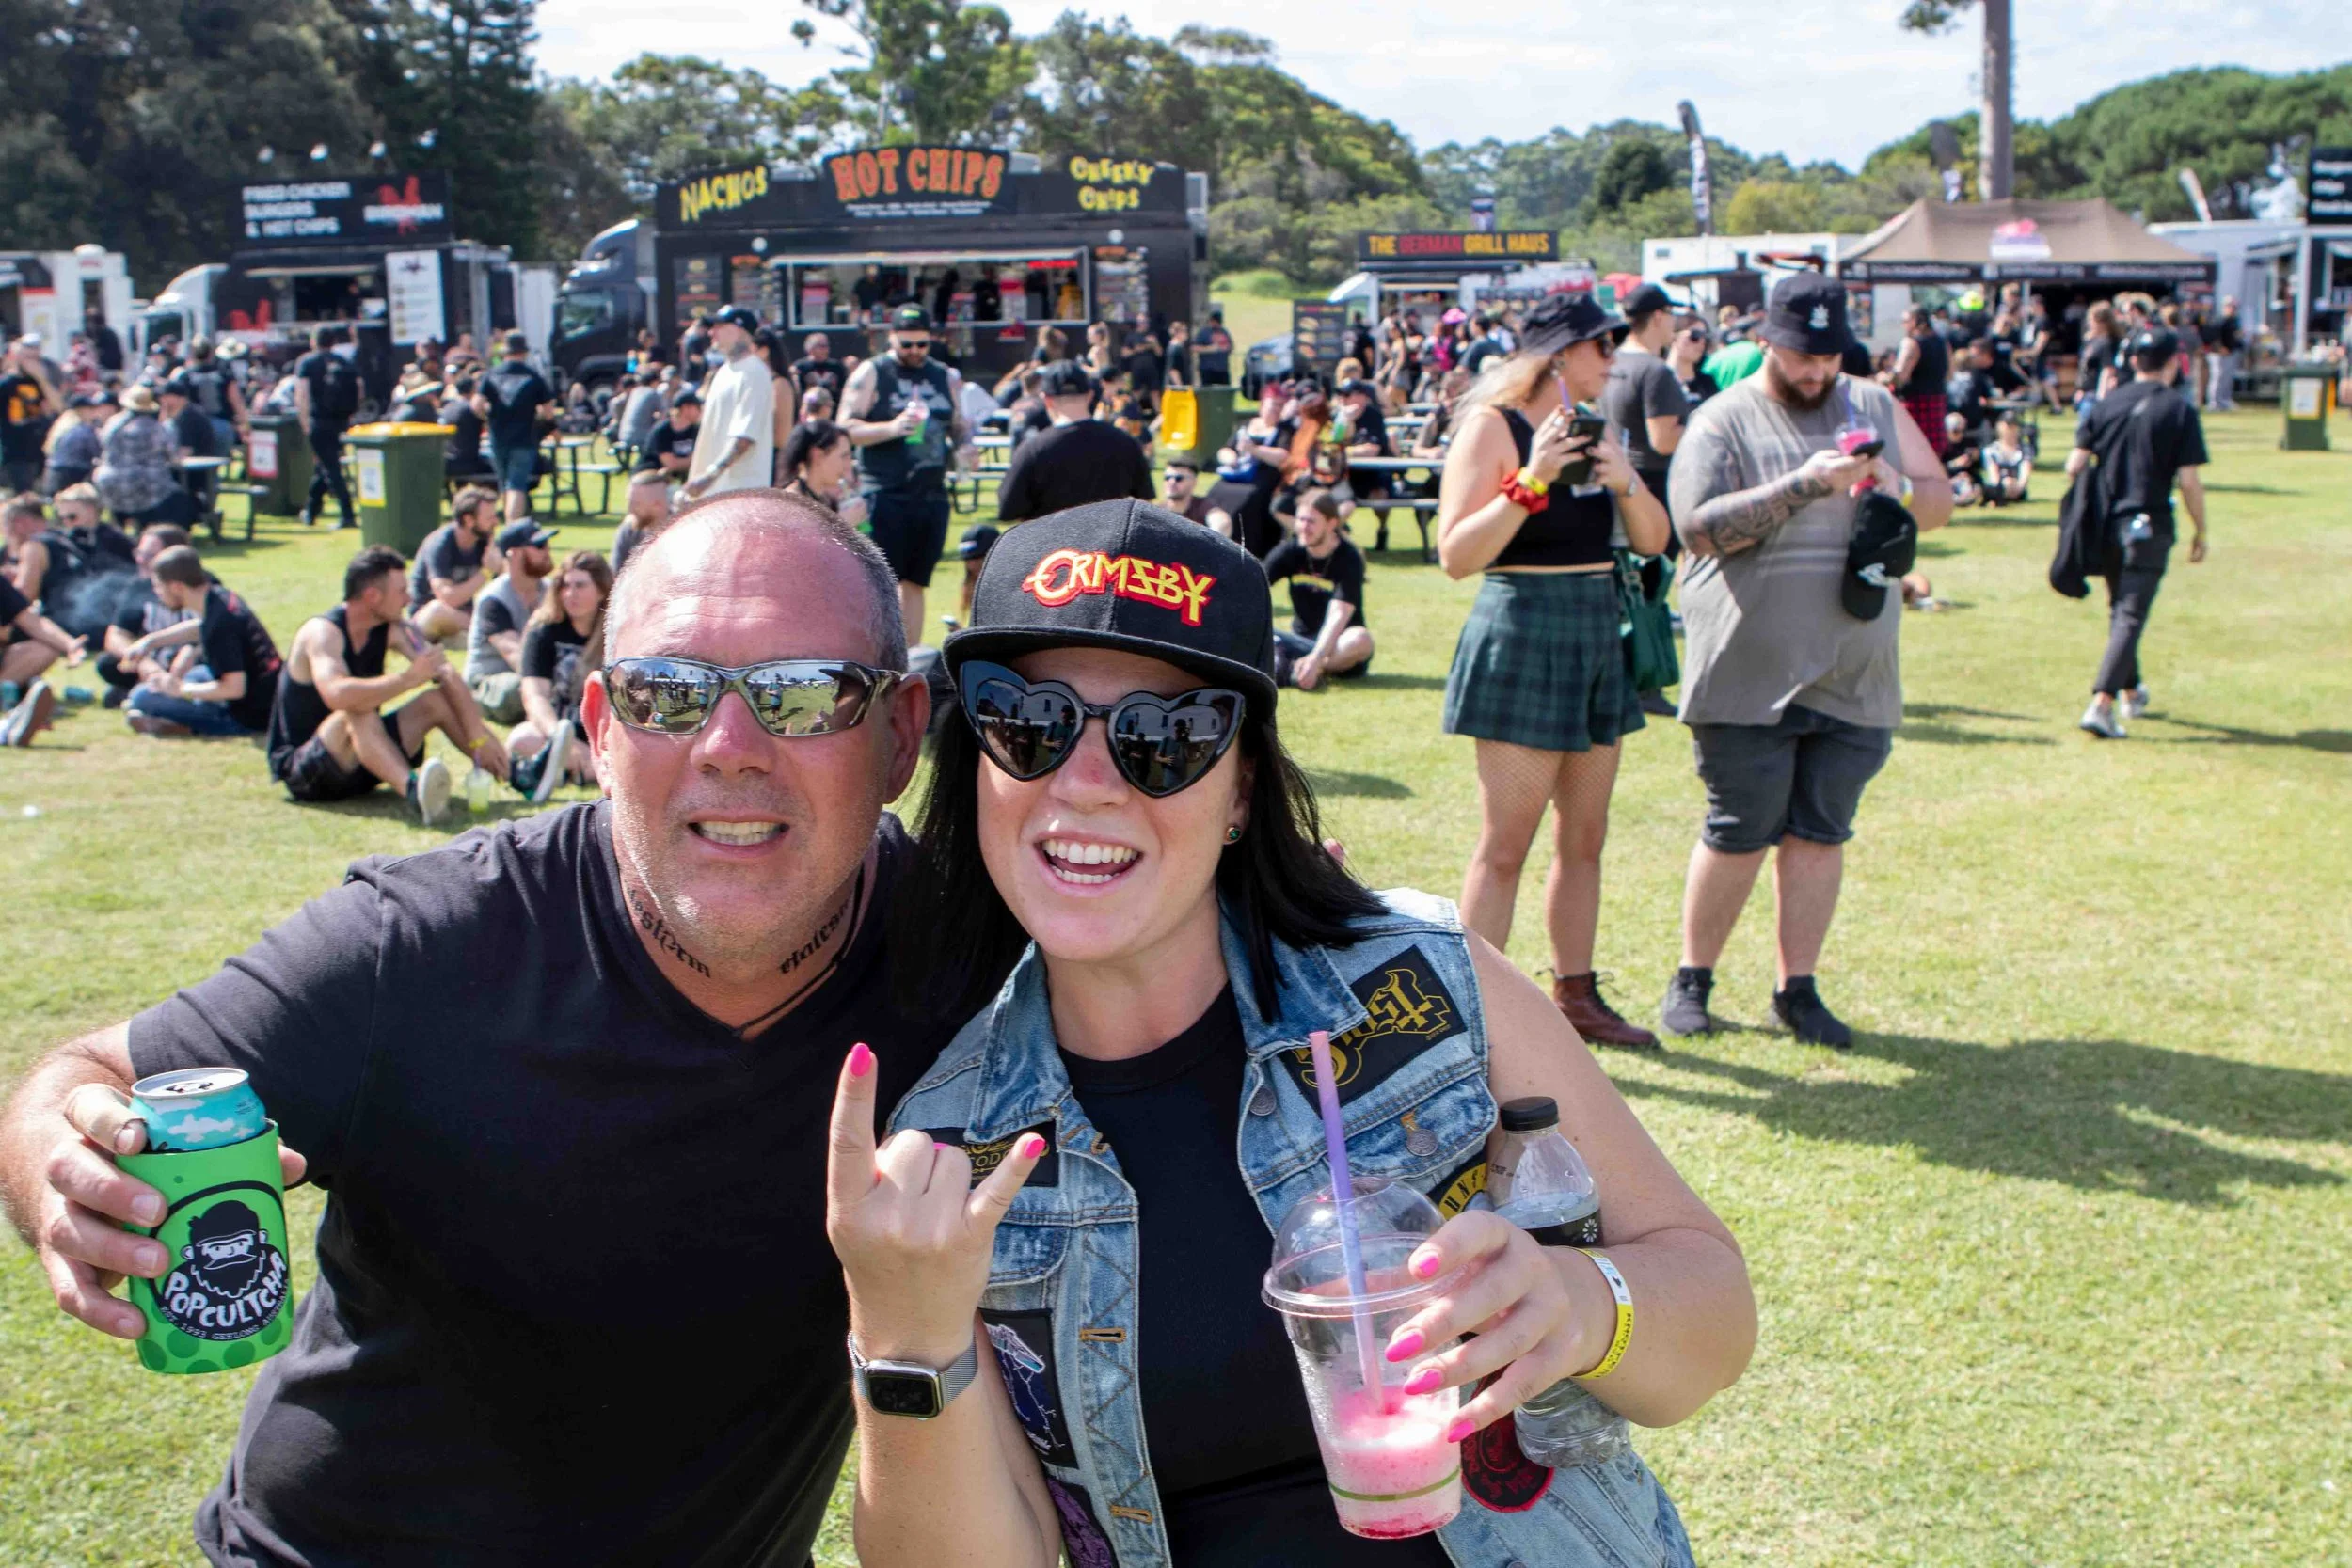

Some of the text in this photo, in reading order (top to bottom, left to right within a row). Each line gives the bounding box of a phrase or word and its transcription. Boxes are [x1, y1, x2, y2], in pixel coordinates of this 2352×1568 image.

[679, 165, 769, 223] NACHOS
[829, 148, 1005, 203] HOT CHIPS
[1368, 235, 1397, 255] THE
[1464, 233, 1504, 254] GRILL
[1023, 548, 1216, 626] ORMSBY
[165, 1251, 286, 1328] POPCULTCHA
